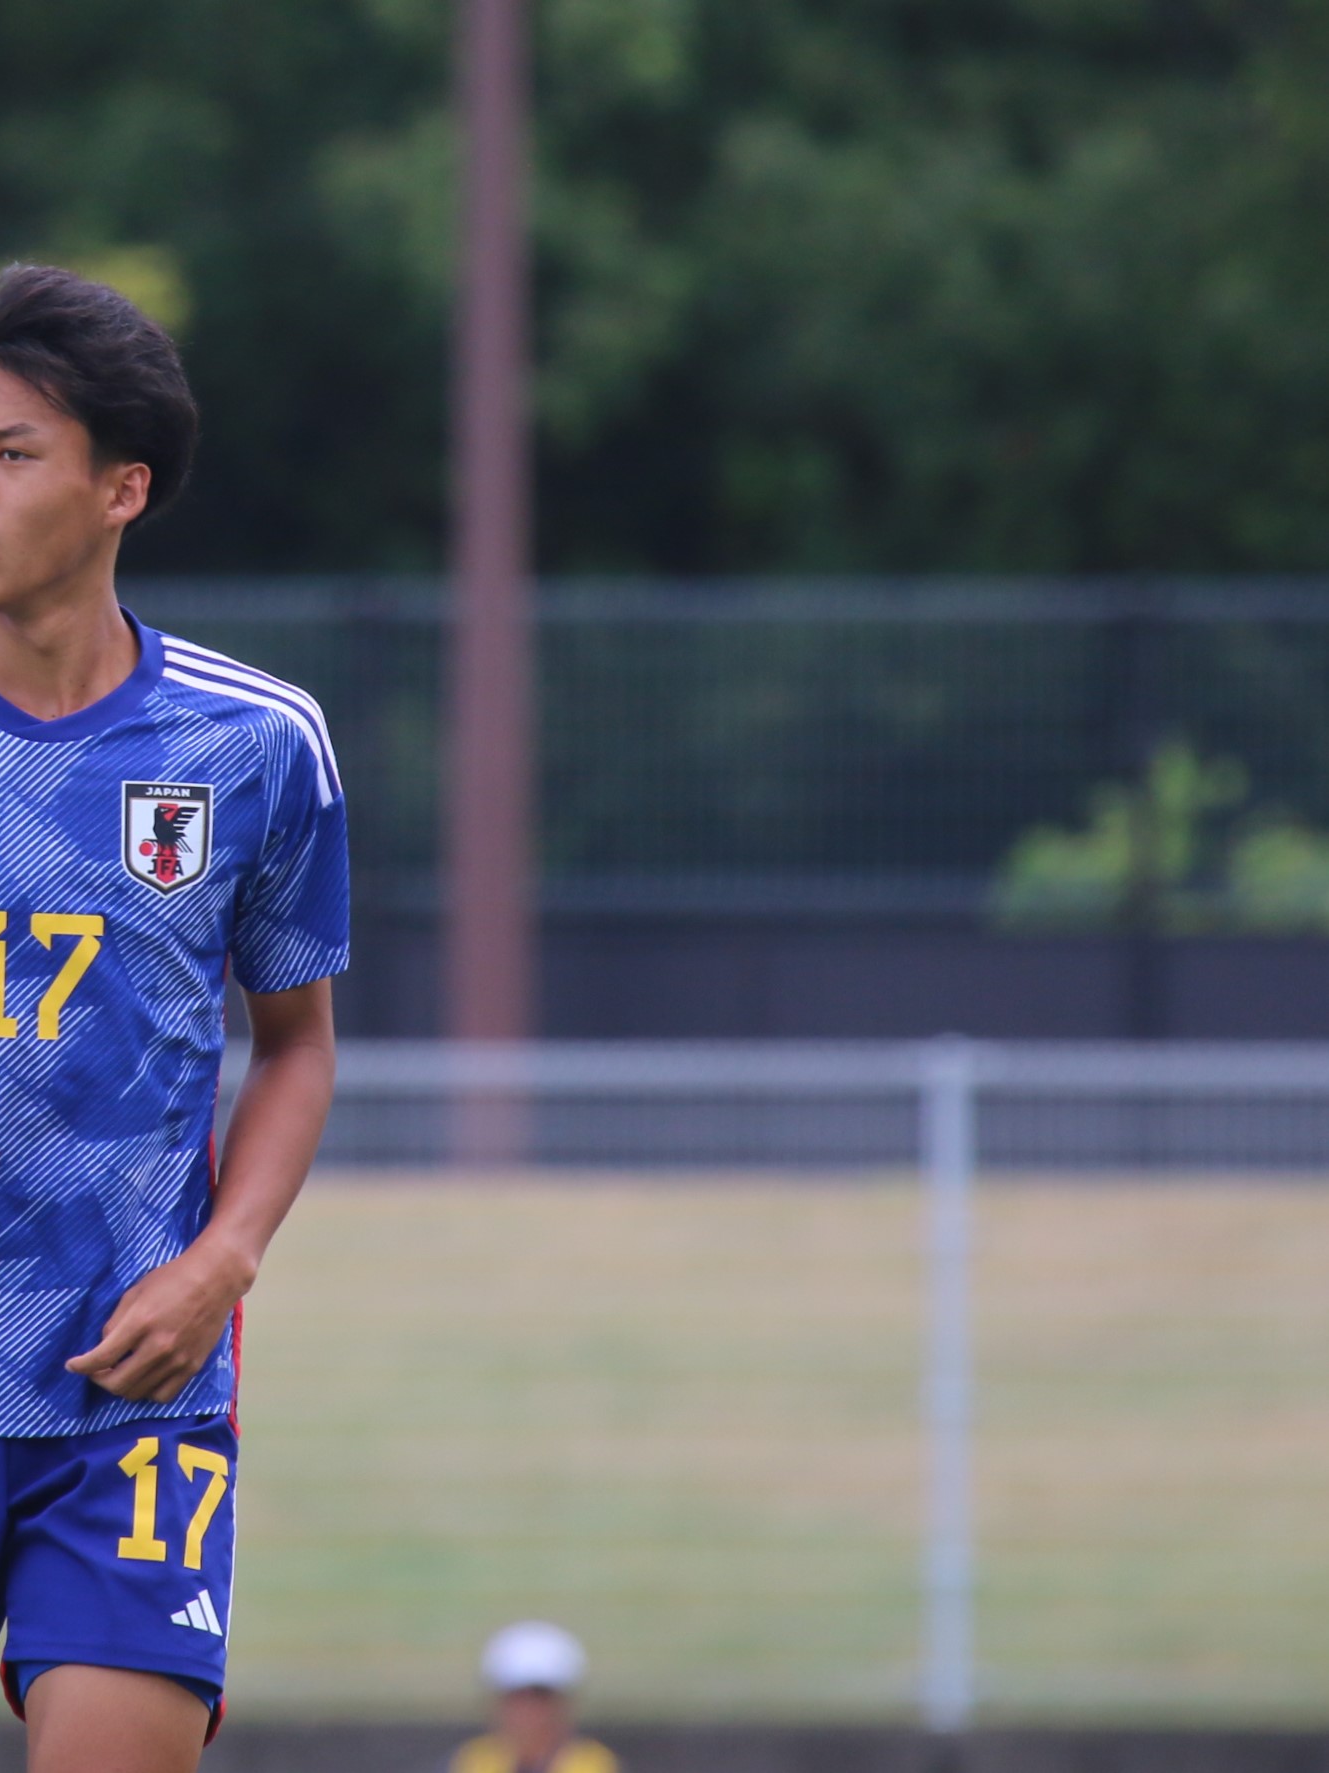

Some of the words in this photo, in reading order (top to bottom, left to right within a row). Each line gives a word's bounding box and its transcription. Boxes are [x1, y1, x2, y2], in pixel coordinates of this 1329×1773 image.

[145, 787, 191, 798] JAPAN
[147, 858, 184, 877] JFA
[117, 1437, 229, 1570] 17
